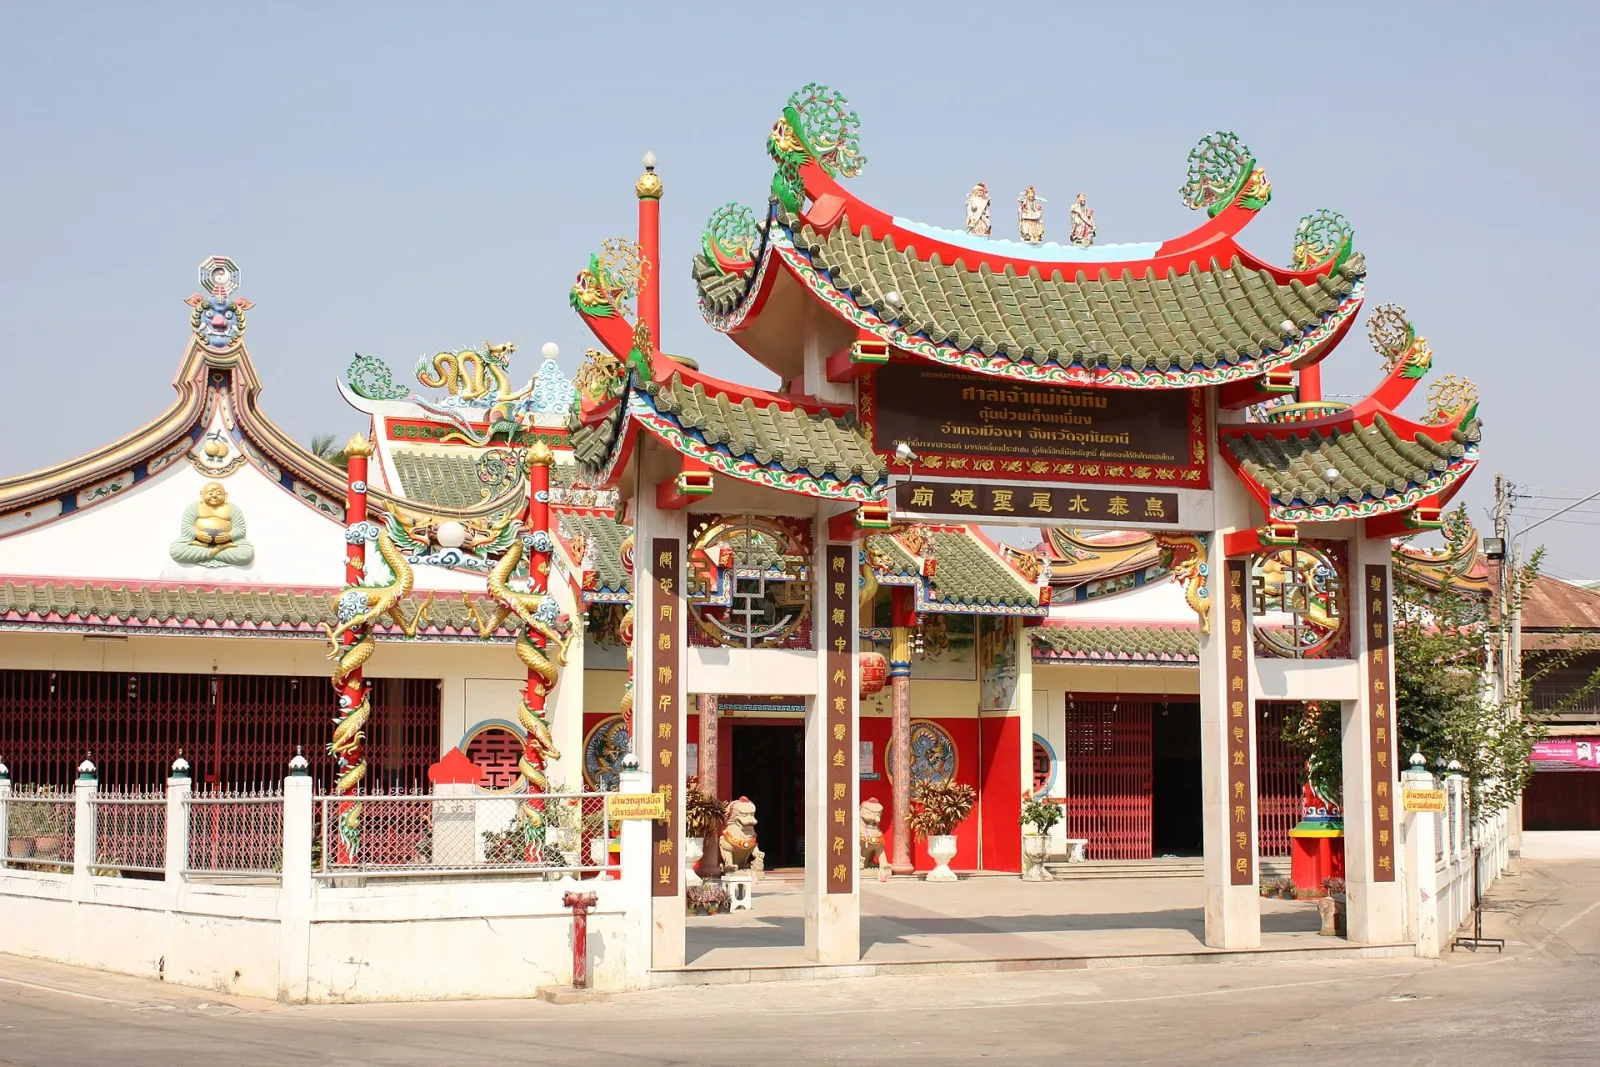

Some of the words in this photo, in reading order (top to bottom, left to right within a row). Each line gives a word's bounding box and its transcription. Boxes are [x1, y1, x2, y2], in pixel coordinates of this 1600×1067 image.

[962, 385, 1107, 408] ศาลเจ้าแม่ทับทิม
[941, 421, 1022, 439] อำเภอเมืองฯ
[1028, 426, 1130, 445] จังหวัดอุทัยธานี
